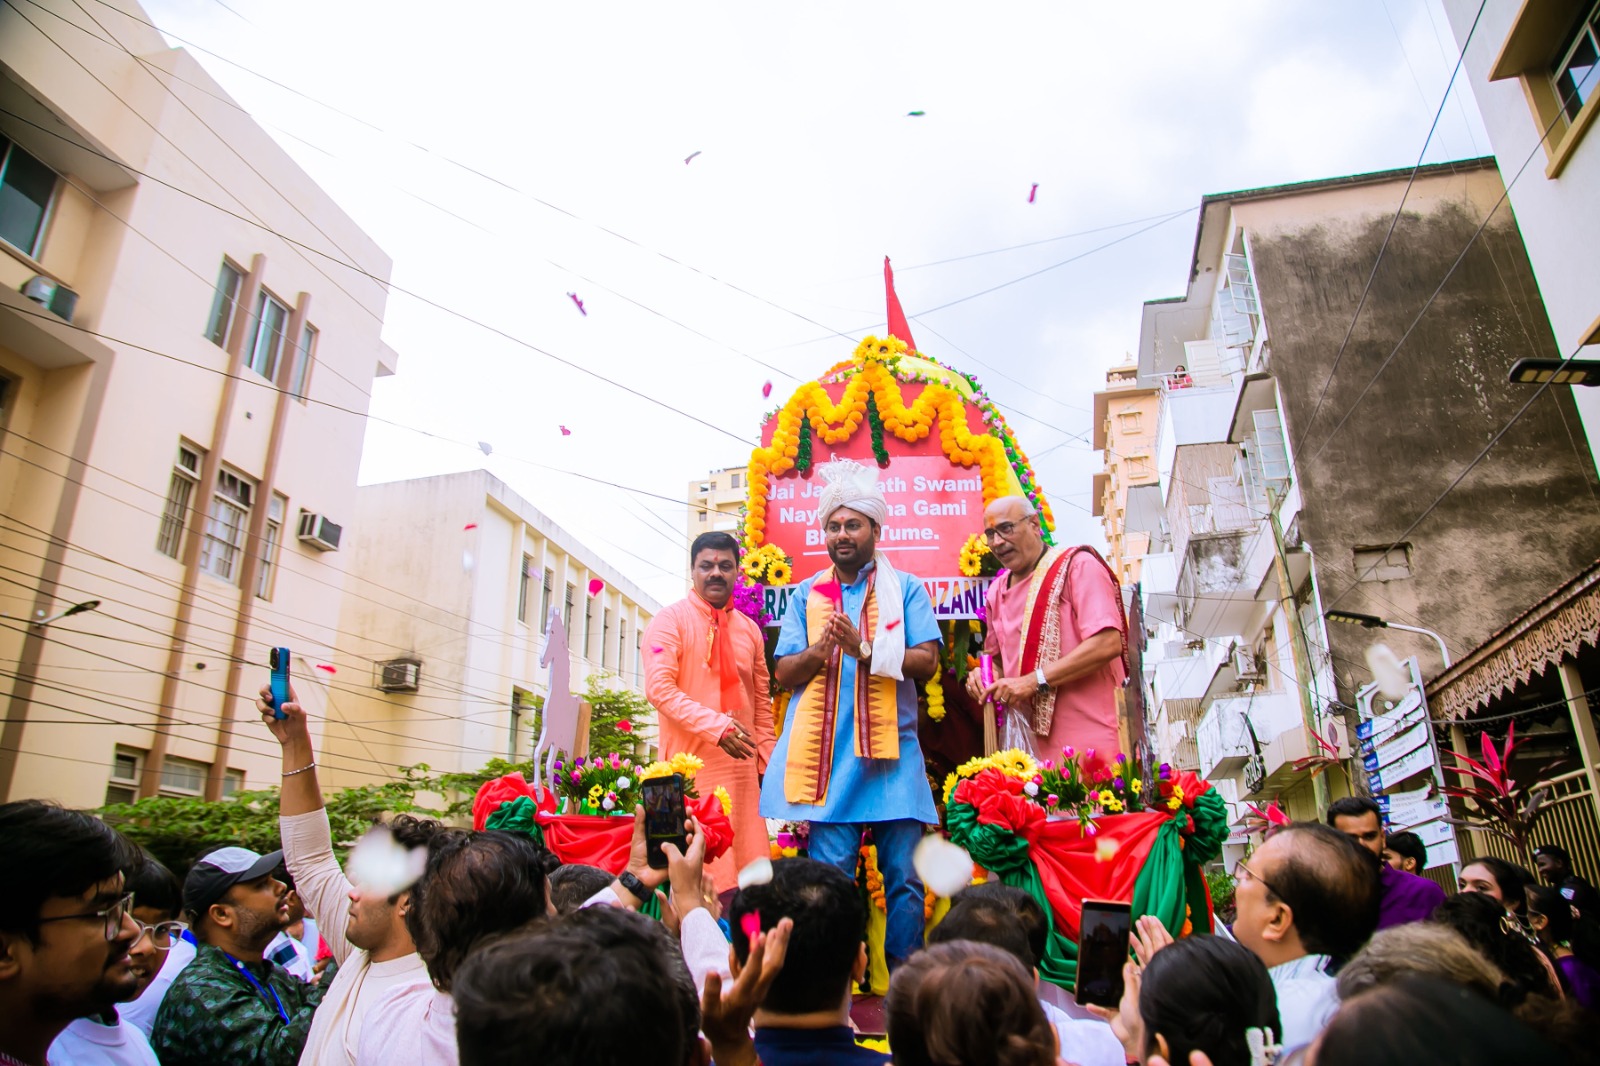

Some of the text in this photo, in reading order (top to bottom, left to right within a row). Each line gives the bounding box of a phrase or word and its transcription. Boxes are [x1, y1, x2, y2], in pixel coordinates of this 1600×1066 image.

[766, 484, 795, 500] Jai
[913, 475, 982, 492] Swami
[913, 499, 967, 516] Gami
[880, 524, 940, 541] Tume.
